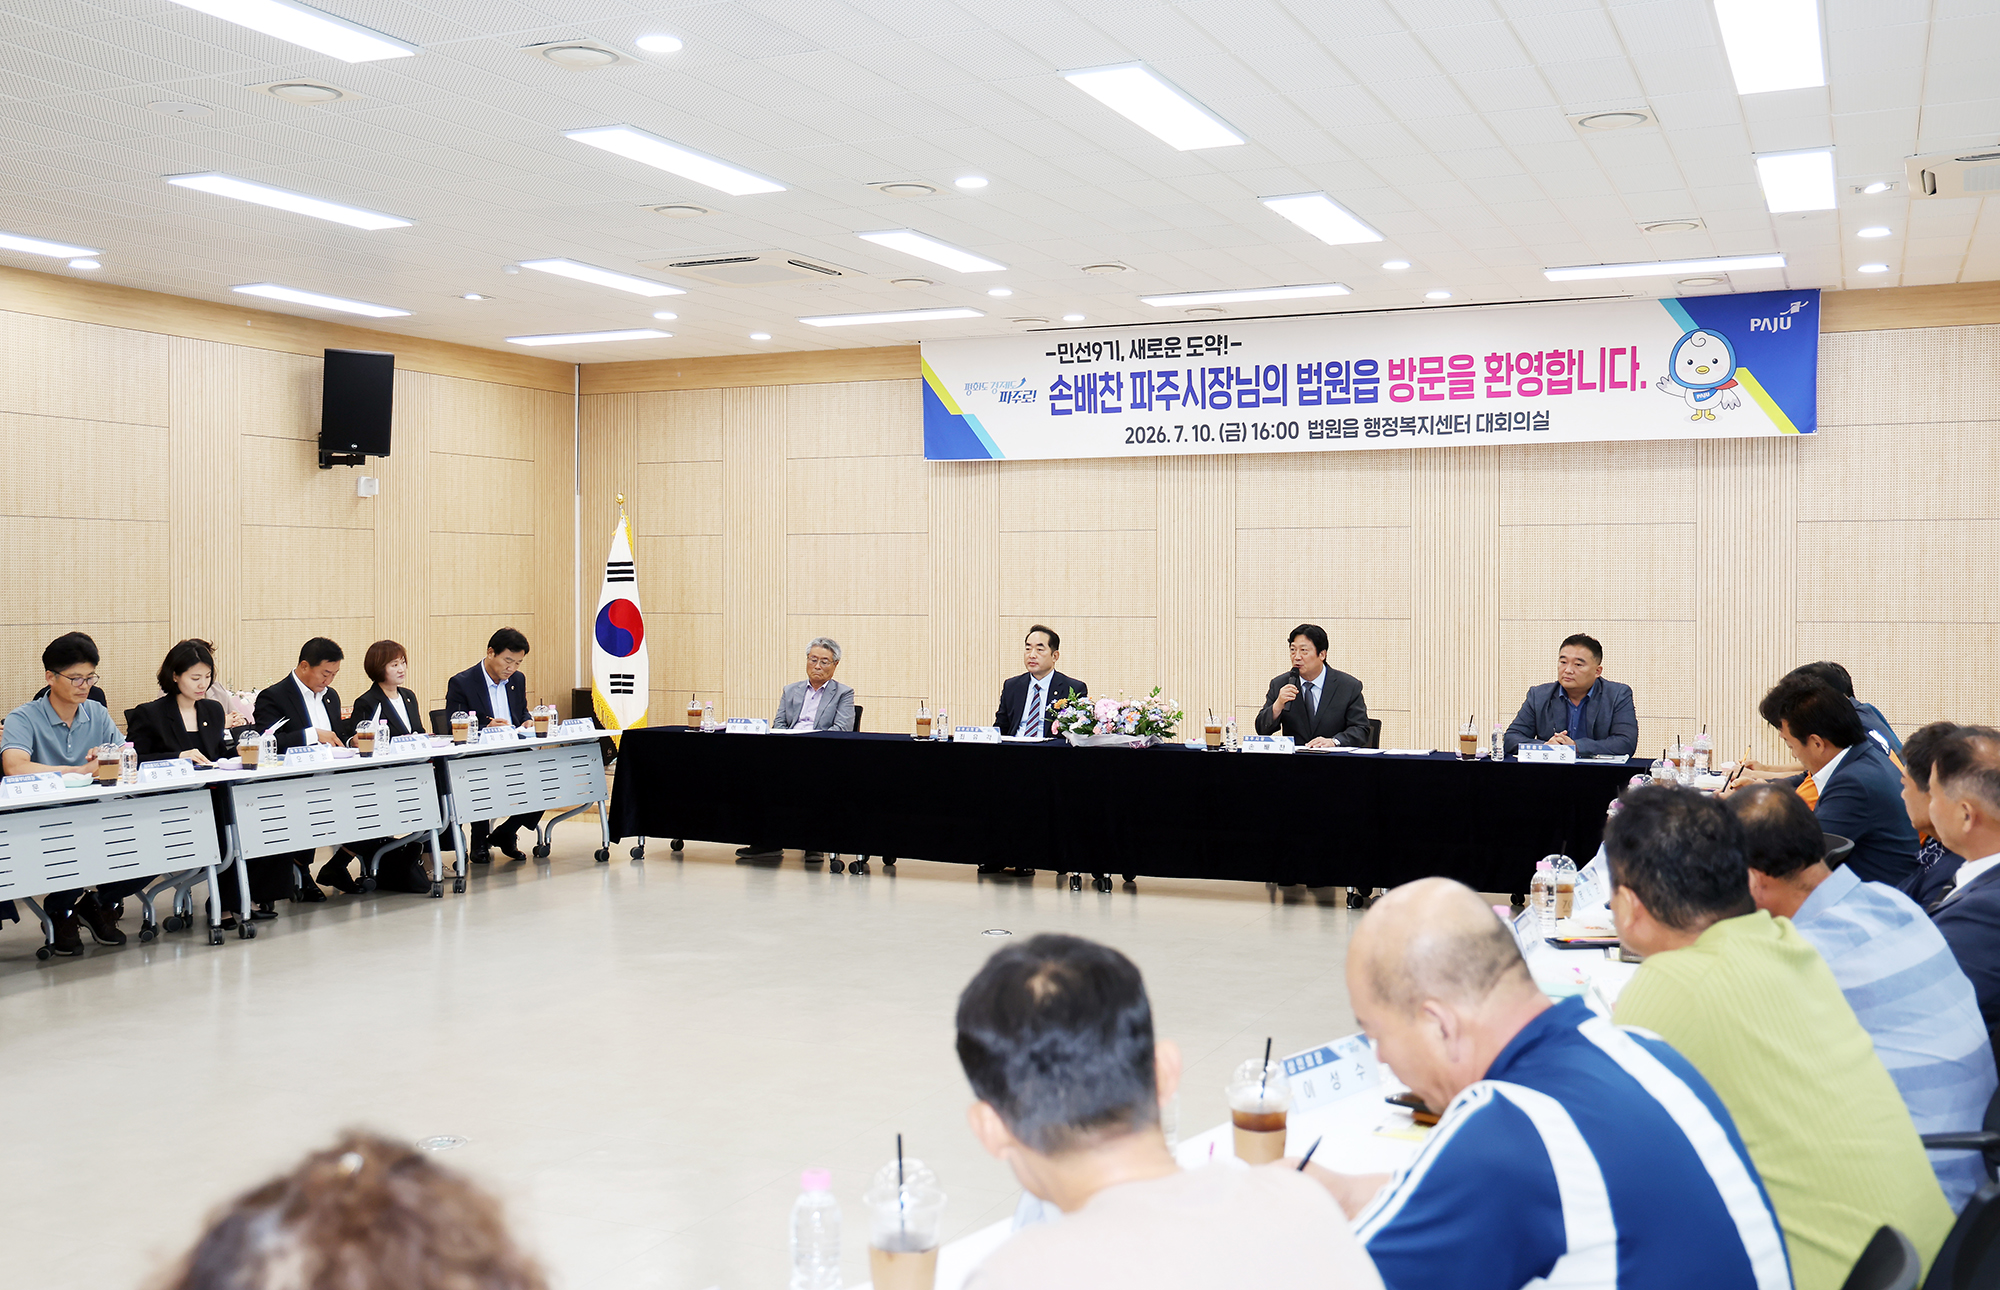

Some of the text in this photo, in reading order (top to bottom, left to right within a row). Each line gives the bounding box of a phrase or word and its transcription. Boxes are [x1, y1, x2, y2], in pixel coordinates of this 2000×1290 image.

[1750, 316, 1792, 333] PAJU
[1128, 337, 1182, 360] 새로운
[964, 380, 1018, 397] 평화도 경제도
[1048, 345, 1647, 416] 손배찬 파주시장님의 법원읍 방문을 환영합니다.
[998, 389, 1037, 405] 파주로!
[1125, 425, 1171, 445] 2026.
[1251, 421, 1300, 441] 16:00
[1307, 418, 1360, 440] 법원읍
[1363, 413, 1471, 438] 행정복지센터
[1475, 410, 1550, 433] 대회의실
